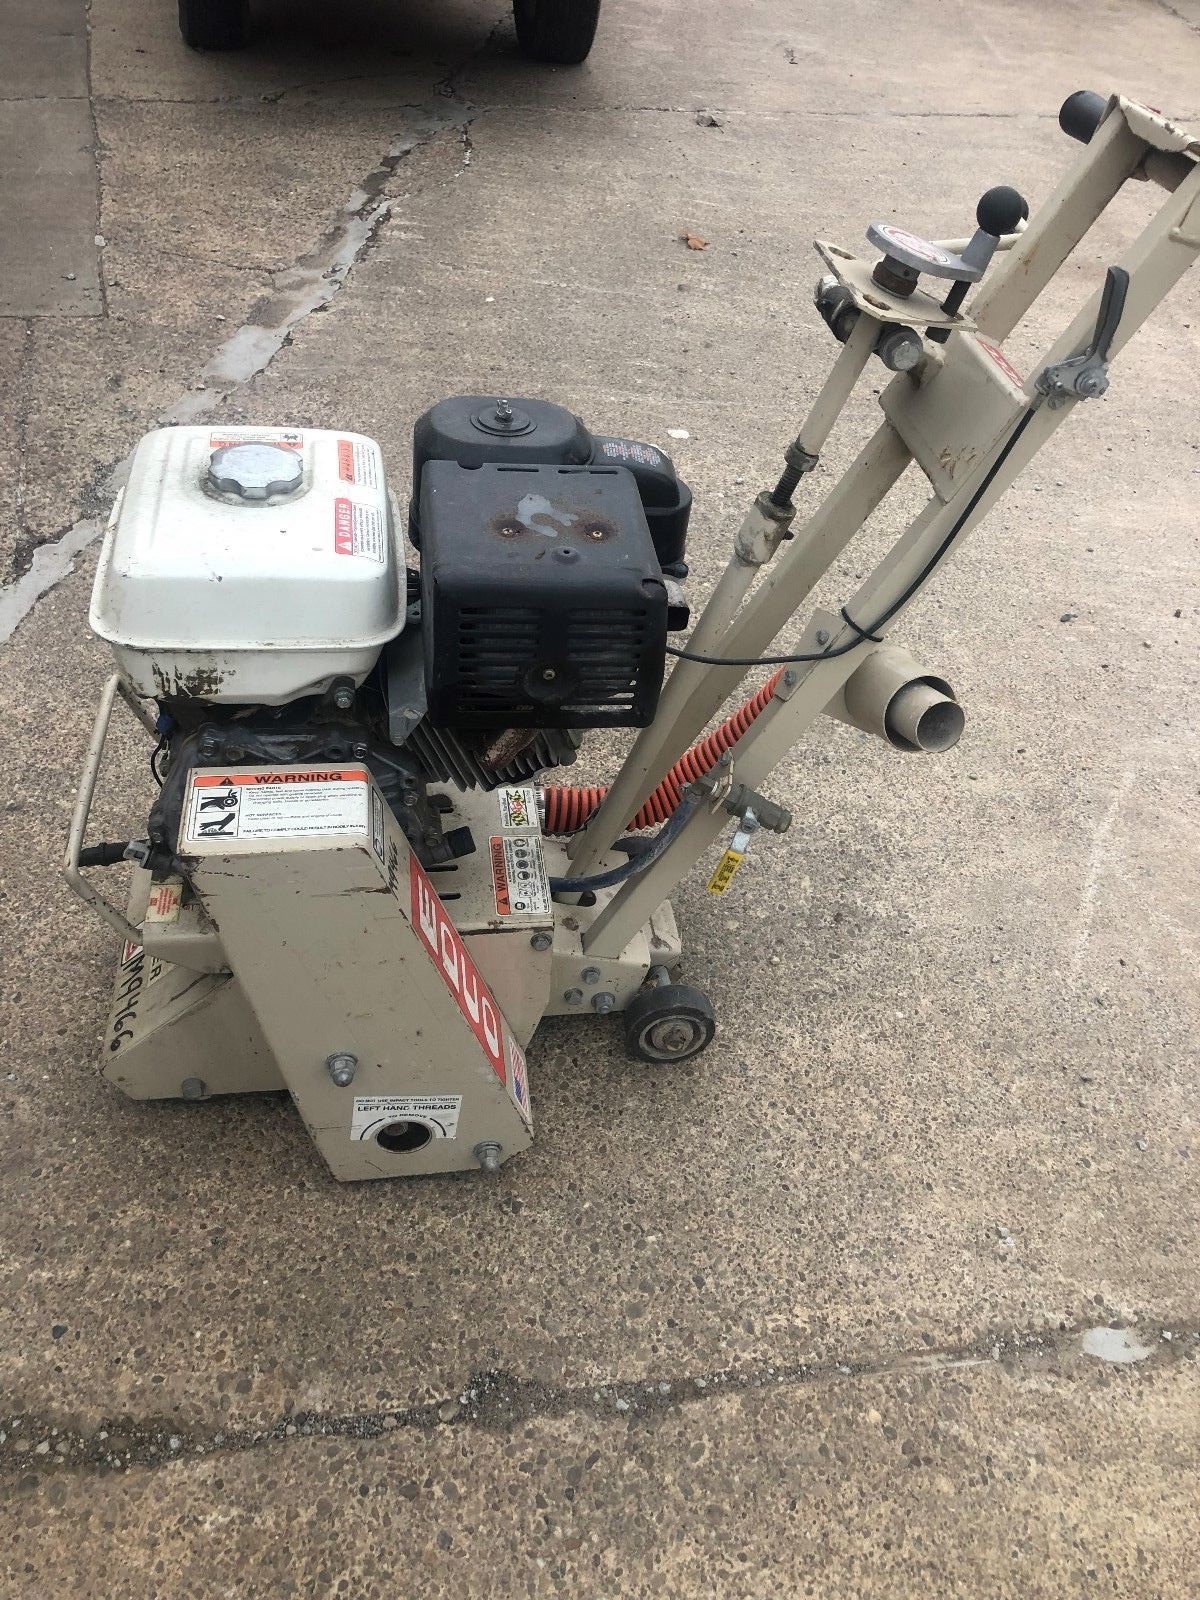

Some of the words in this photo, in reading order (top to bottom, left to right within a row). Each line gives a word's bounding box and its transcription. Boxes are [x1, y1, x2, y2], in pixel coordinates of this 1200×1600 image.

[339, 503, 351, 537] DANGER
[254, 773, 343, 783] WARNING
[493, 843, 507, 892] WARNING
[418, 875, 499, 1058] EDCO
[110, 953, 145, 1051] M9466
